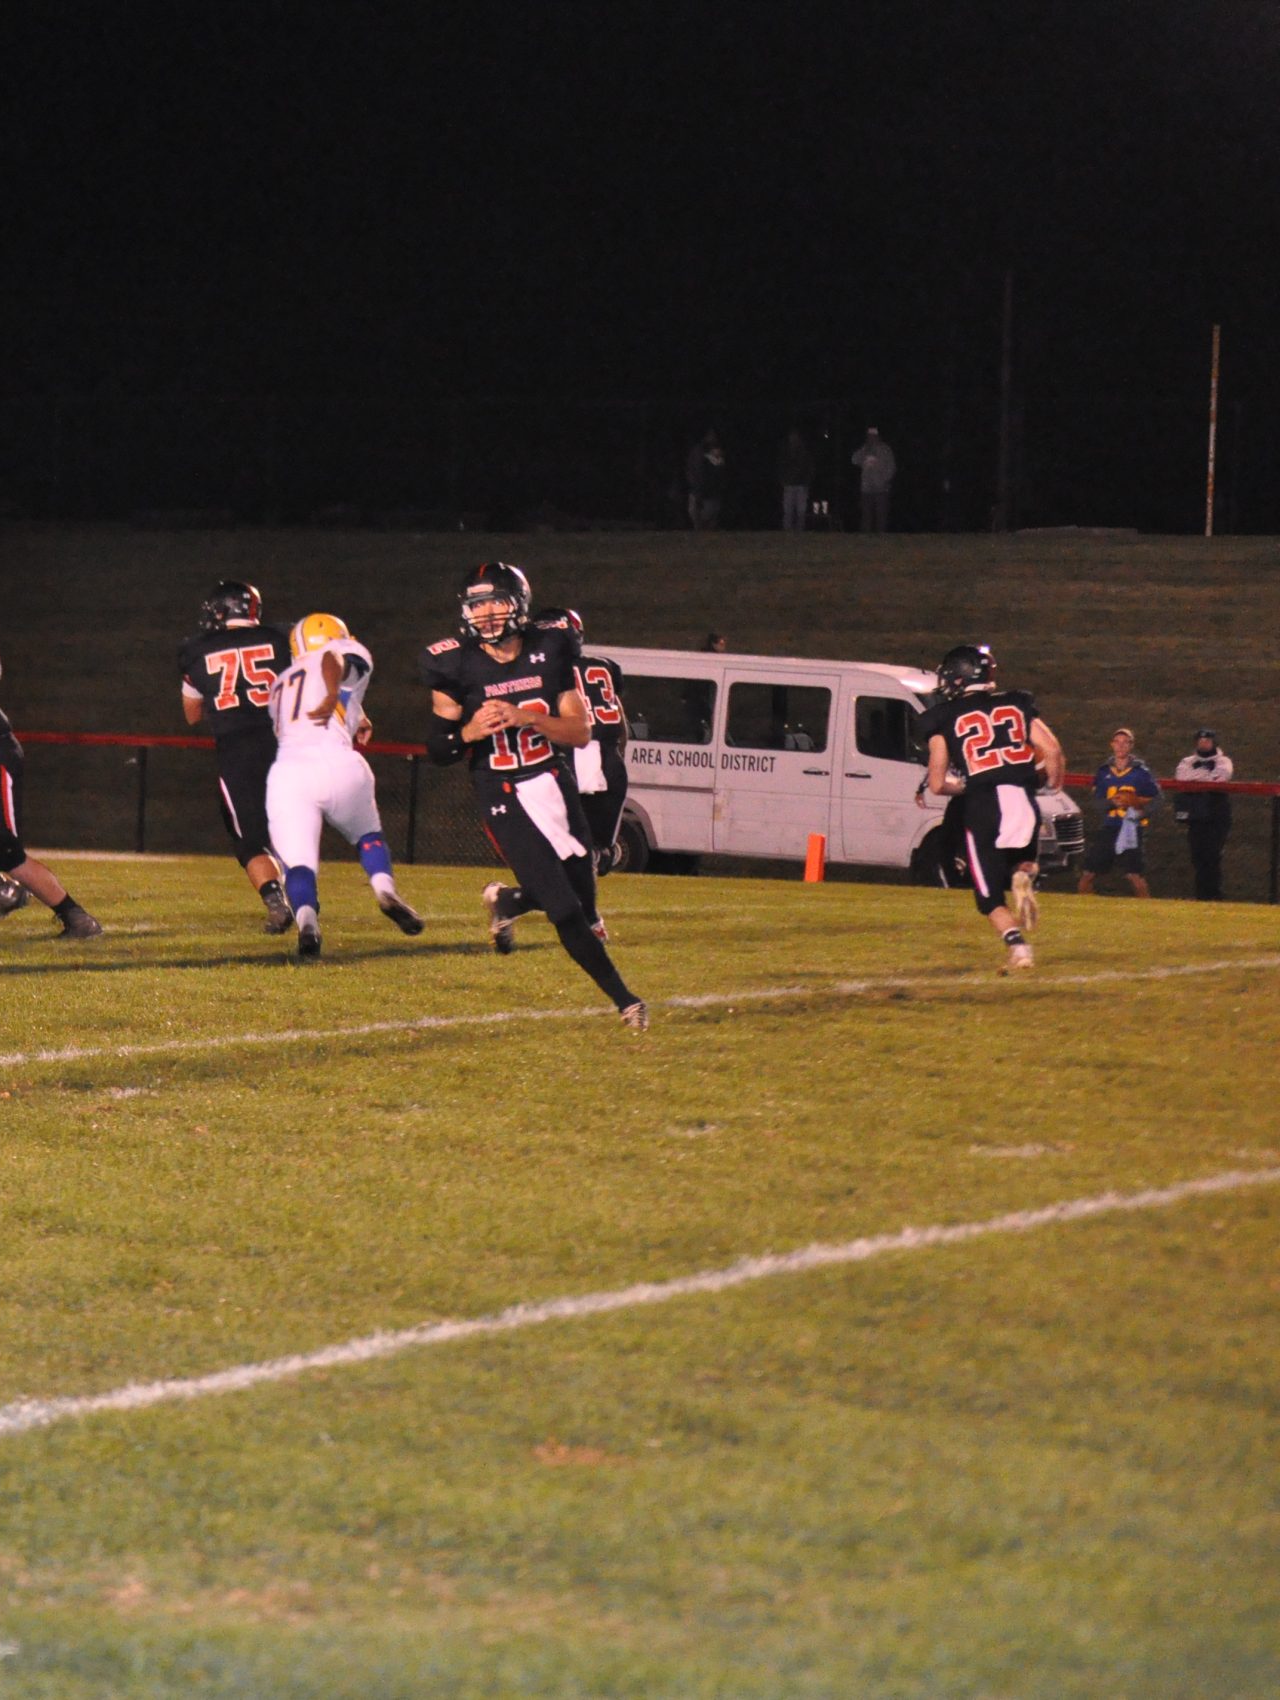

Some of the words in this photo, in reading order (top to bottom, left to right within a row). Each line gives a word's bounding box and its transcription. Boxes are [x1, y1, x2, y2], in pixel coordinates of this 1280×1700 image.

[205, 643, 278, 711] 75
[272, 668, 308, 737] 77
[489, 698, 555, 770] 12
[631, 747, 662, 765] AREA
[668, 750, 715, 769] SCHOOL
[721, 753, 776, 773] DISTRICT
[954, 705, 1035, 777] 23
